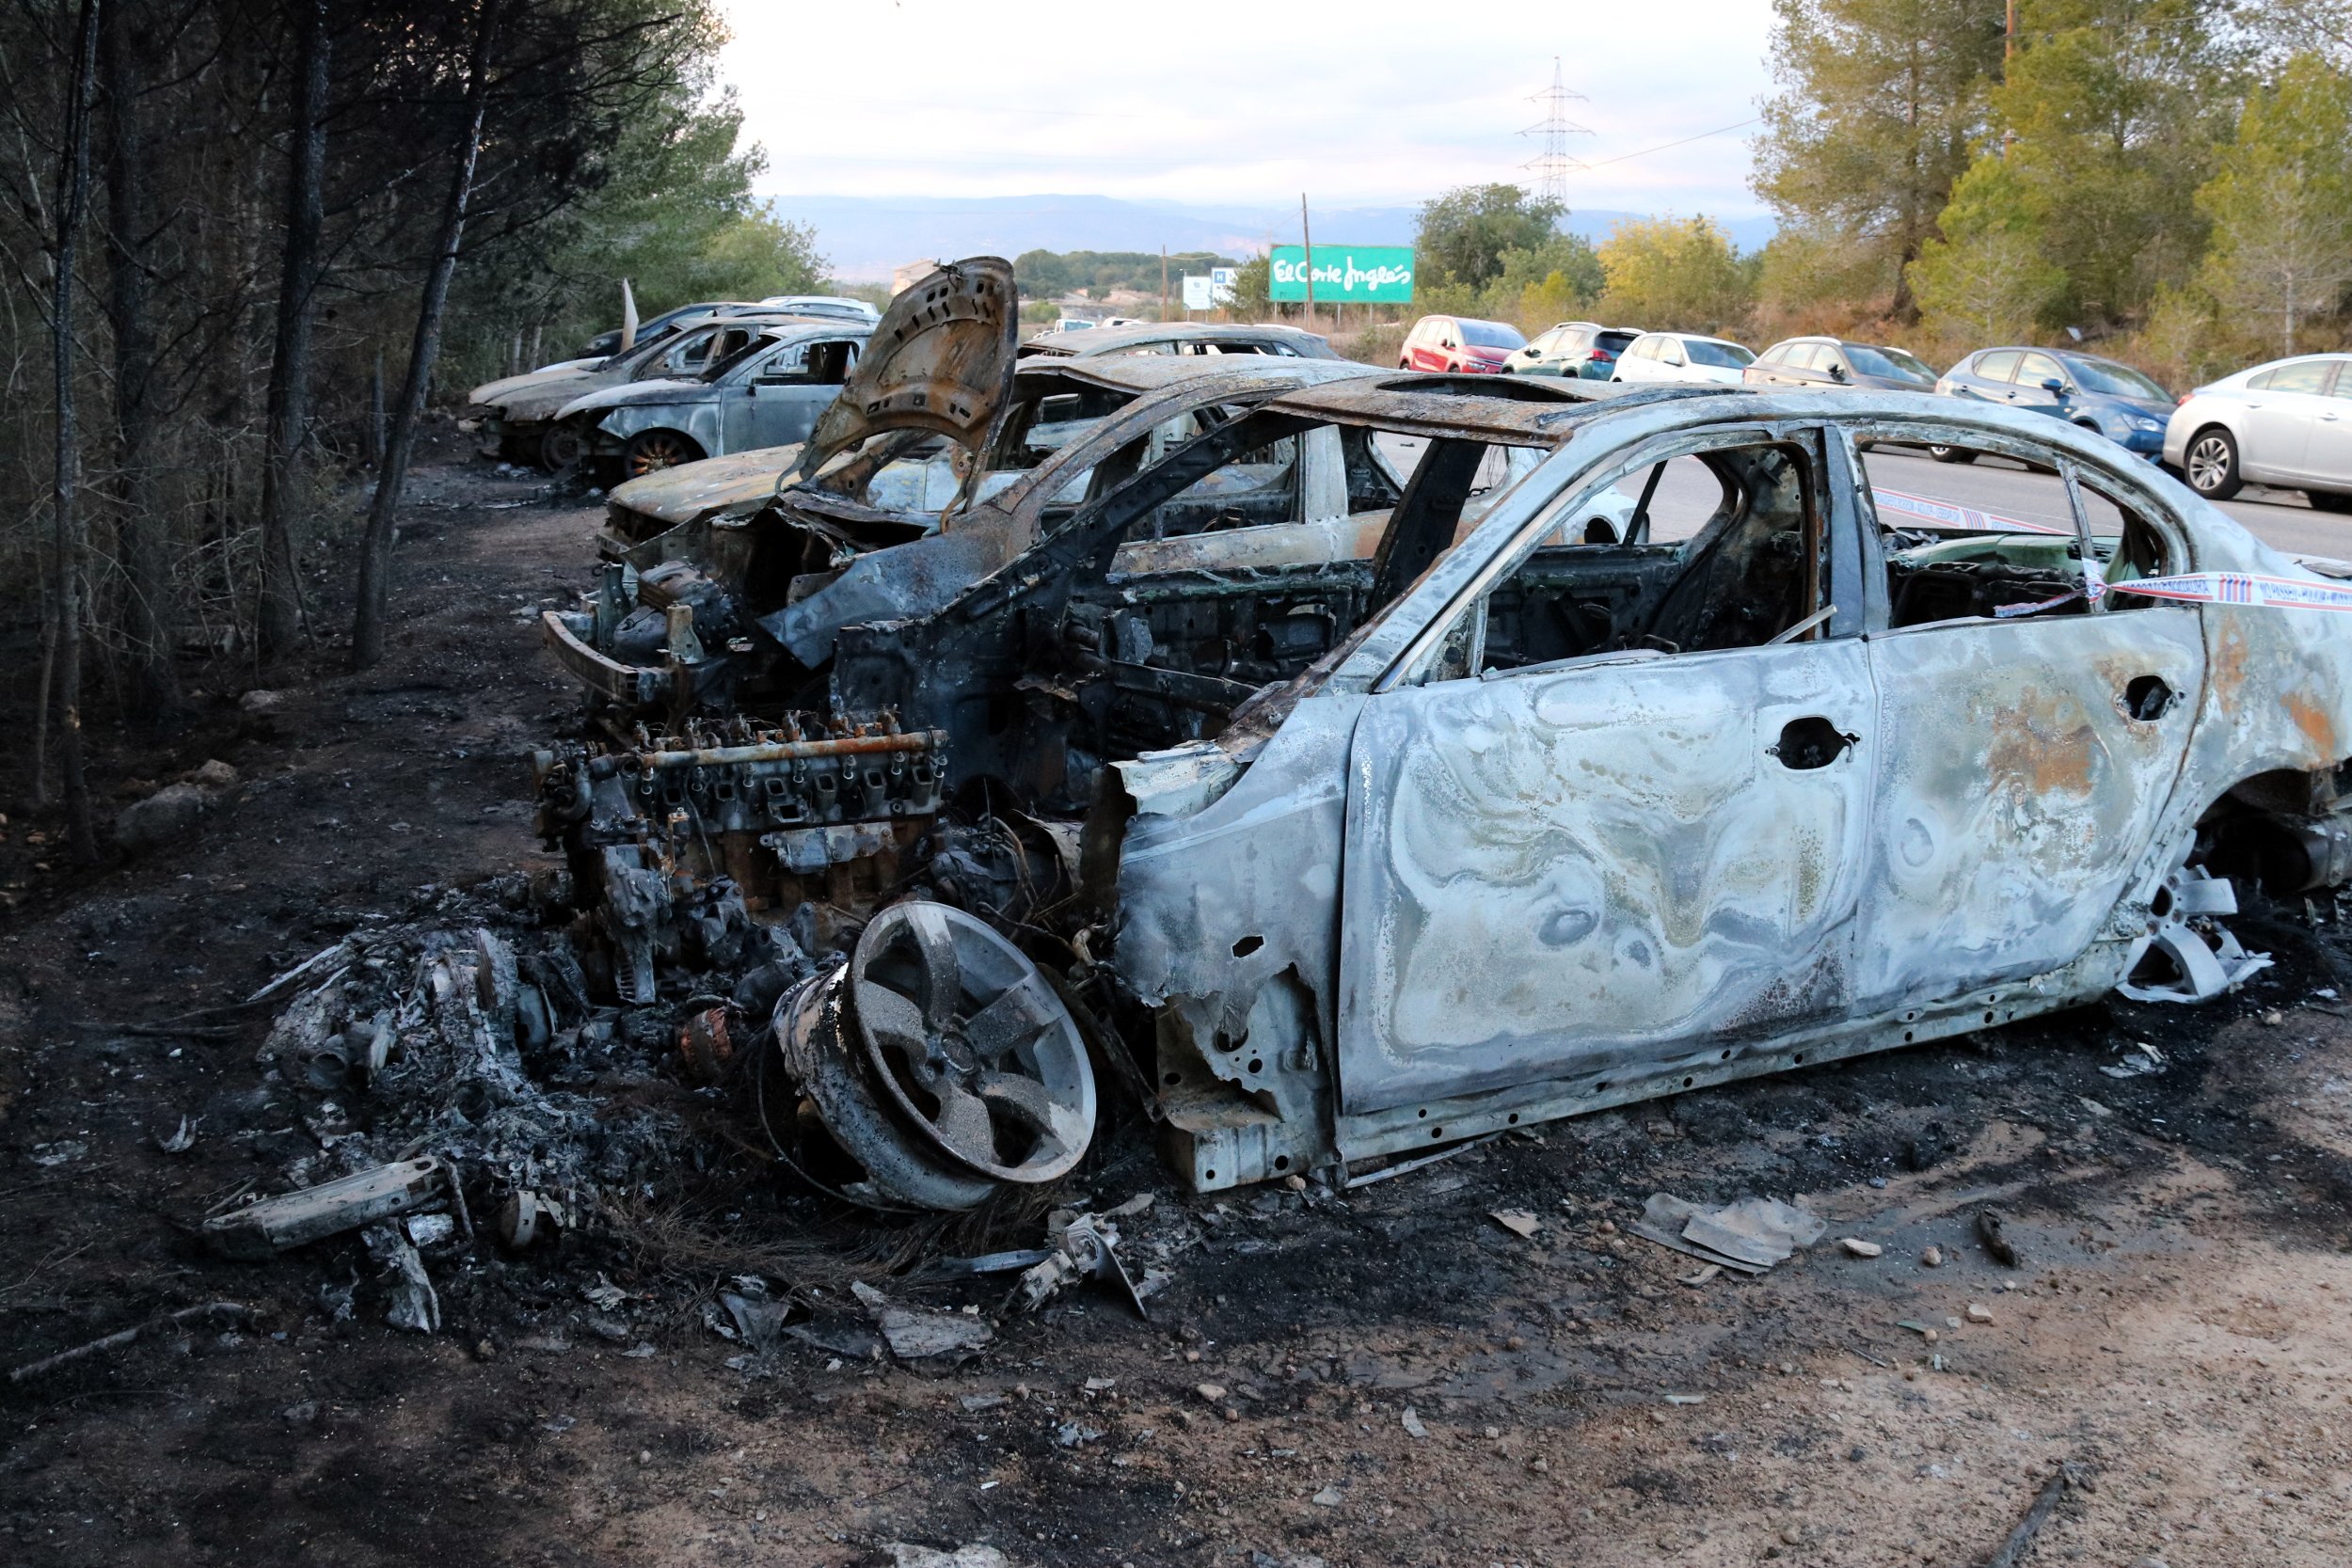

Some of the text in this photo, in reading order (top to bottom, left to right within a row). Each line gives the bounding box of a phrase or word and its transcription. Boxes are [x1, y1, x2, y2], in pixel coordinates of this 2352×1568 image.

[1273, 256, 1411, 292] El Corte Inglés
